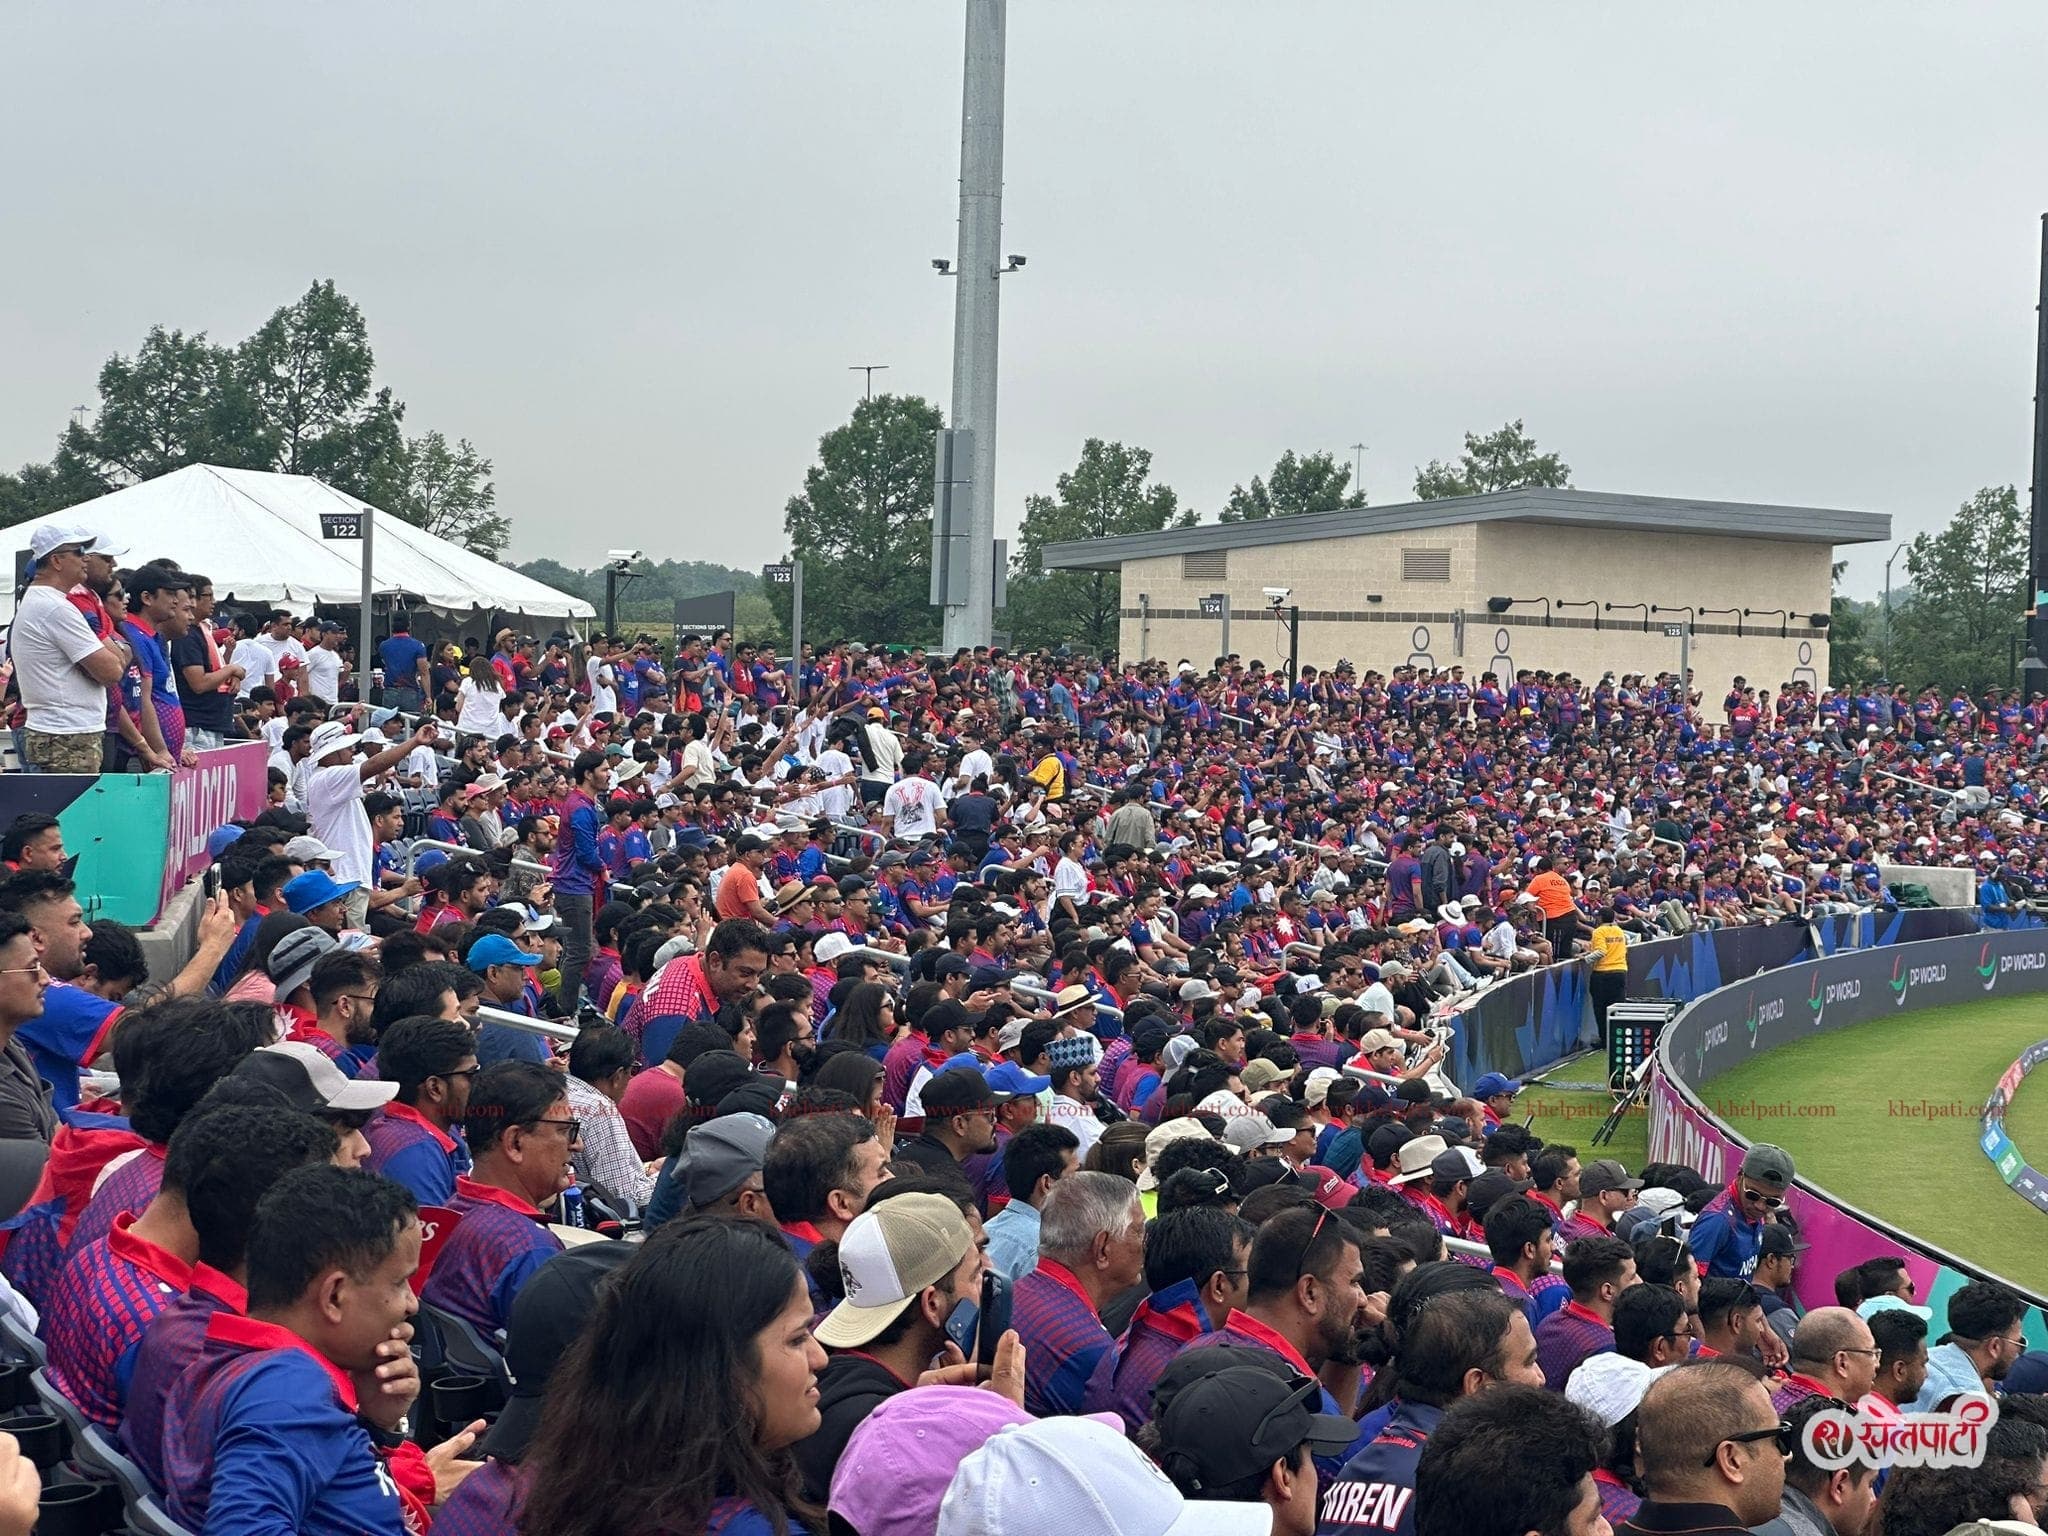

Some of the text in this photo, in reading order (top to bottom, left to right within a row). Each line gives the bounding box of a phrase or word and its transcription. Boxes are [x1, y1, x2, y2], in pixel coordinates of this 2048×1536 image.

[332, 525, 357, 537] 122
[773, 573, 791, 583] 123
[1205, 604, 1221, 613] 124
[2001, 952, 2046, 973] DP WORLD
[1909, 964, 1947, 987] DP WORLD
[1826, 979, 1861, 1005] DP WORLD
[1766, 998, 1784, 1022] WORLD
